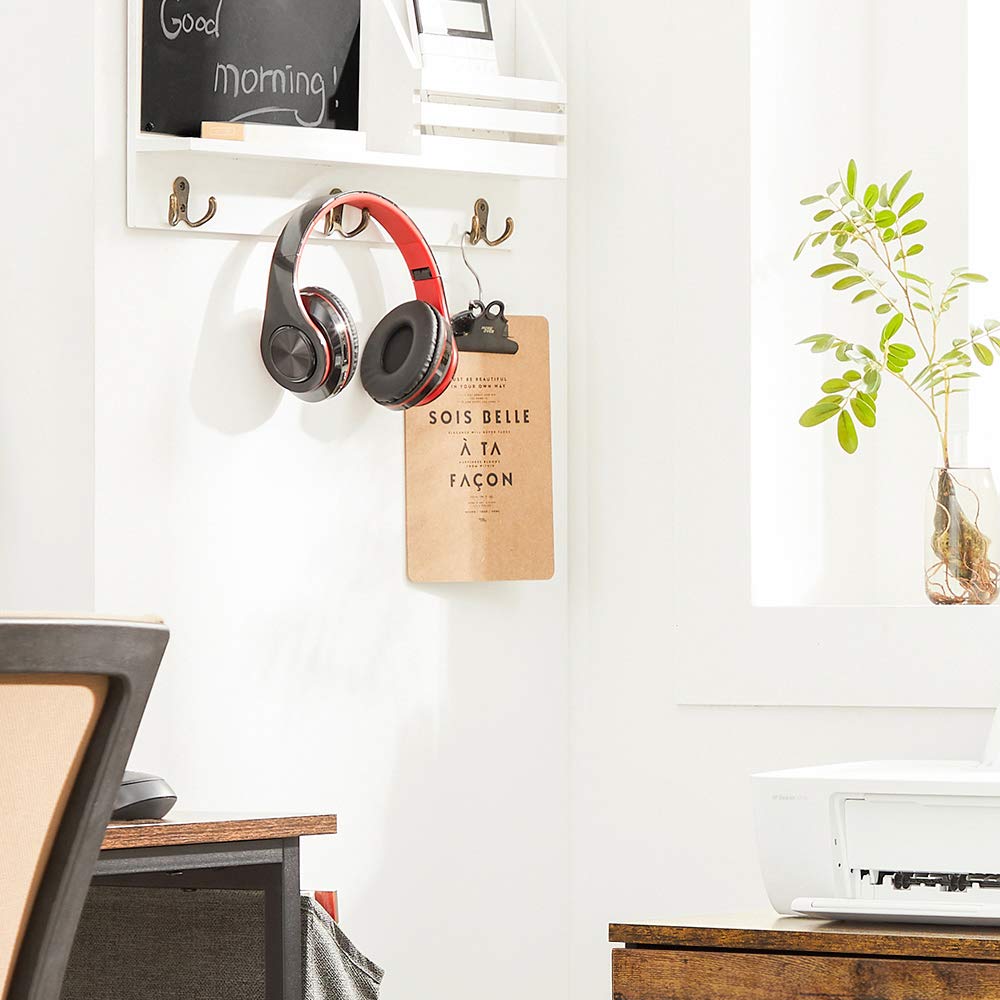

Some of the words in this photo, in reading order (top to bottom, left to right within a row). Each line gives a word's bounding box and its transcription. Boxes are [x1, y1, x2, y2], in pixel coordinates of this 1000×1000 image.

[160, 0, 222, 40] Good
[429, 410, 472, 424] SOIS
[482, 409, 530, 424] BELLE
[460, 437, 471, 456] À
[480, 441, 501, 456] TA
[450, 472, 513, 492] FAÇON
